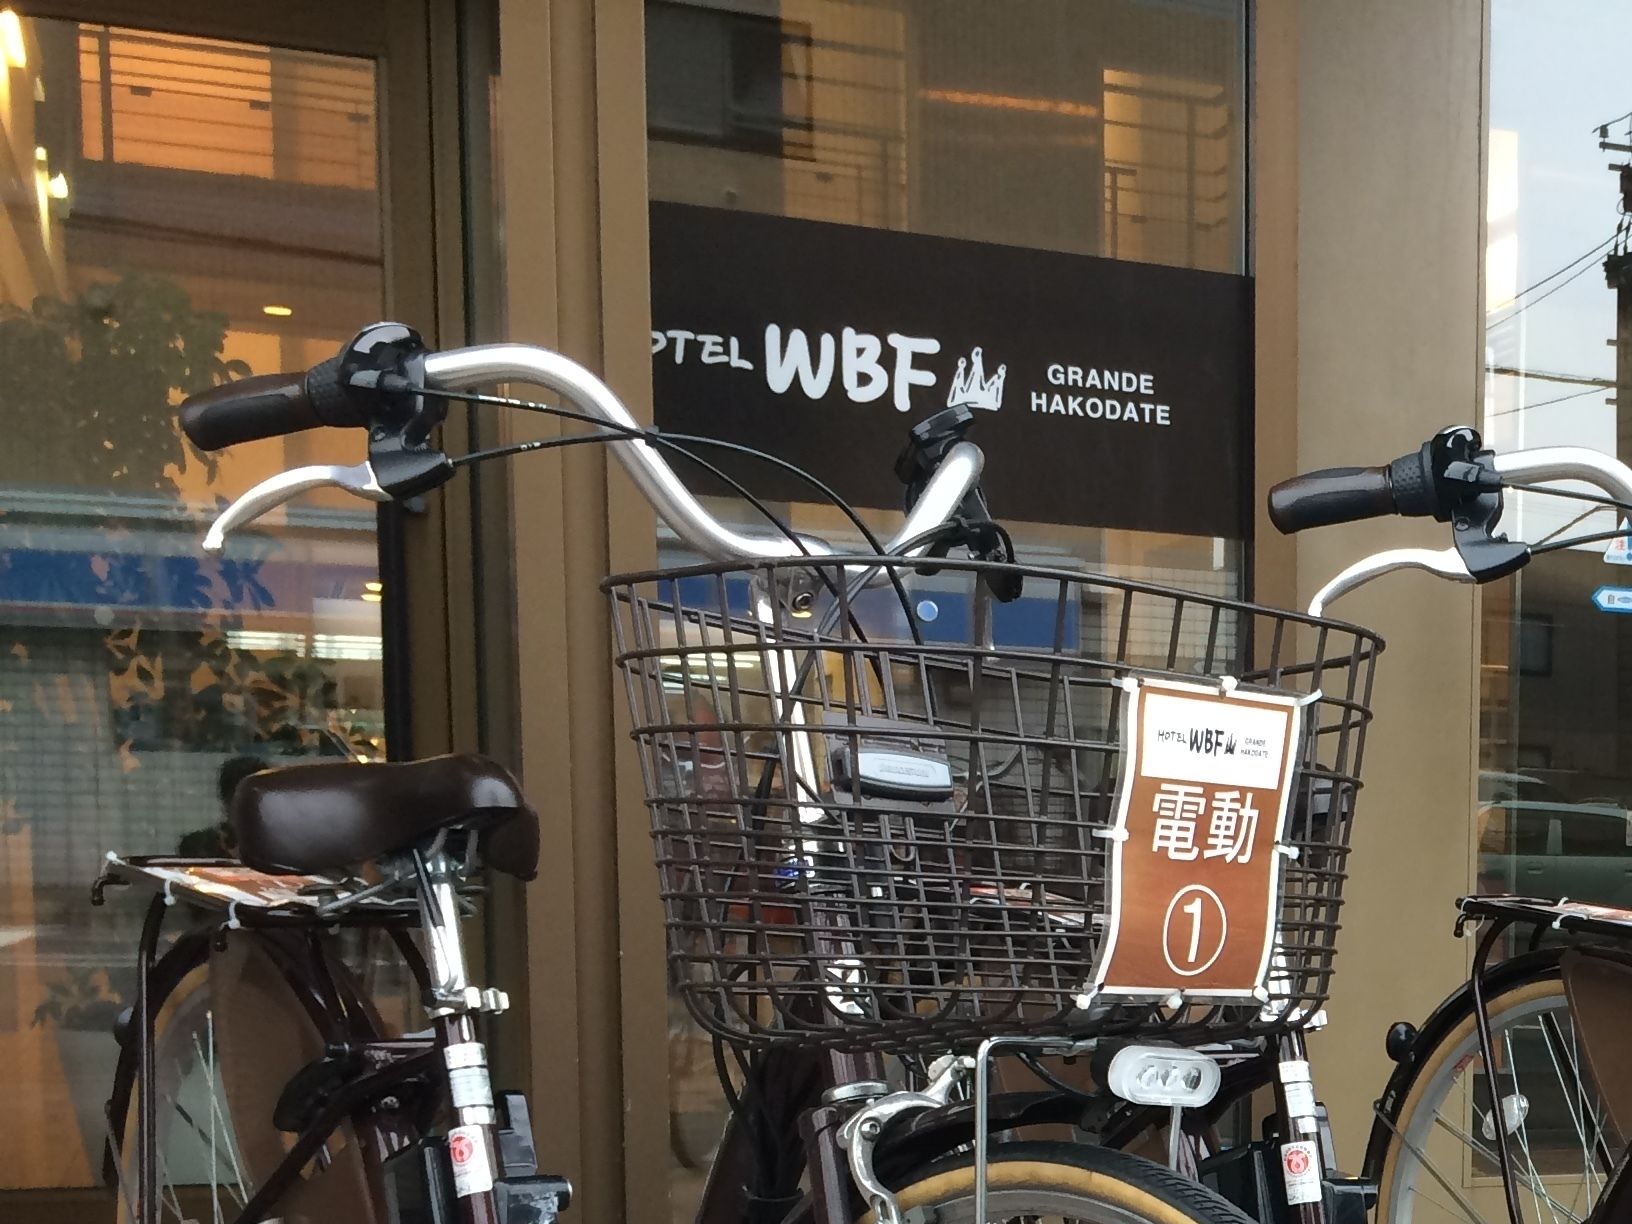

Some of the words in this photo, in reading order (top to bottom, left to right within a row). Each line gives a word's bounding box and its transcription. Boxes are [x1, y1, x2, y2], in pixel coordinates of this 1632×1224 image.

[765, 323, 941, 412] WBF
[1047, 363, 1155, 395] GRANDE
[1030, 391, 1170, 426] HAKODATE
[1157, 729, 1187, 744] HOTEL
[1189, 727, 1224, 757] WBF
[1152, 783, 1259, 864] 電動
